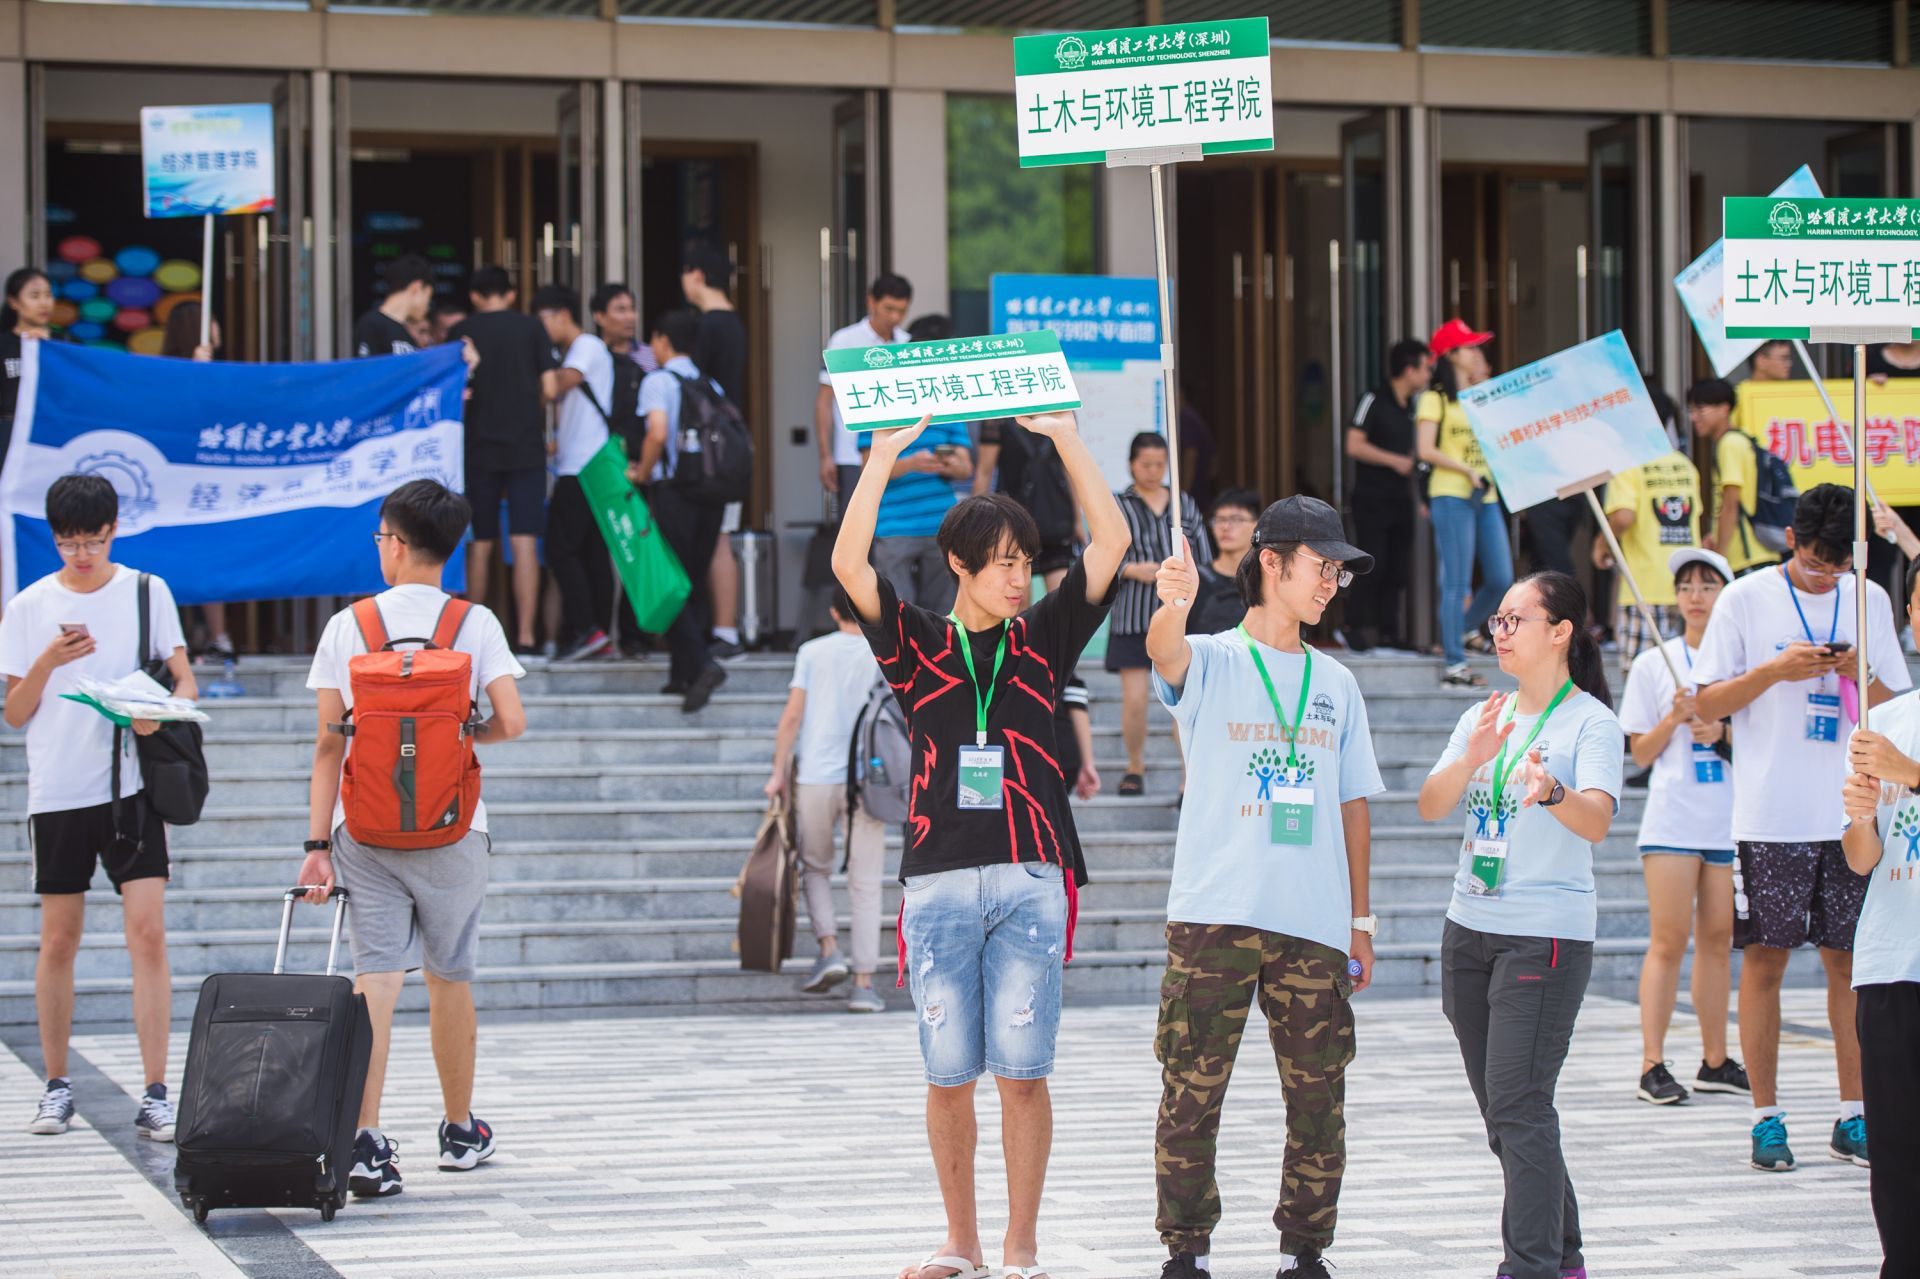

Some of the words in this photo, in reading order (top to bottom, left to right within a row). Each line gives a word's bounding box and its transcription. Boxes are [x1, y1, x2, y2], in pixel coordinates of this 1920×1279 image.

[1091, 57, 1115, 66] HARBIN
[1116, 55, 1146, 64] INSTITUTE
[1147, 54, 1155, 62] OF
[1156, 51, 1198, 61] TECHNOLOGY,
[1198, 49, 1231, 58] SHENZHEN
[1028, 76, 1262, 134] 土木与环境工程学院
[1807, 228, 1832, 236] HARBIN
[1833, 228, 1865, 236] INSTITUTE
[1866, 228, 1875, 236] OF
[1876, 228, 1919, 237] TECHNOLOGY,
[846, 363, 1066, 411] 土木与环境工程学院
[1496, 387, 1633, 450] 计算机科学与技术学院
